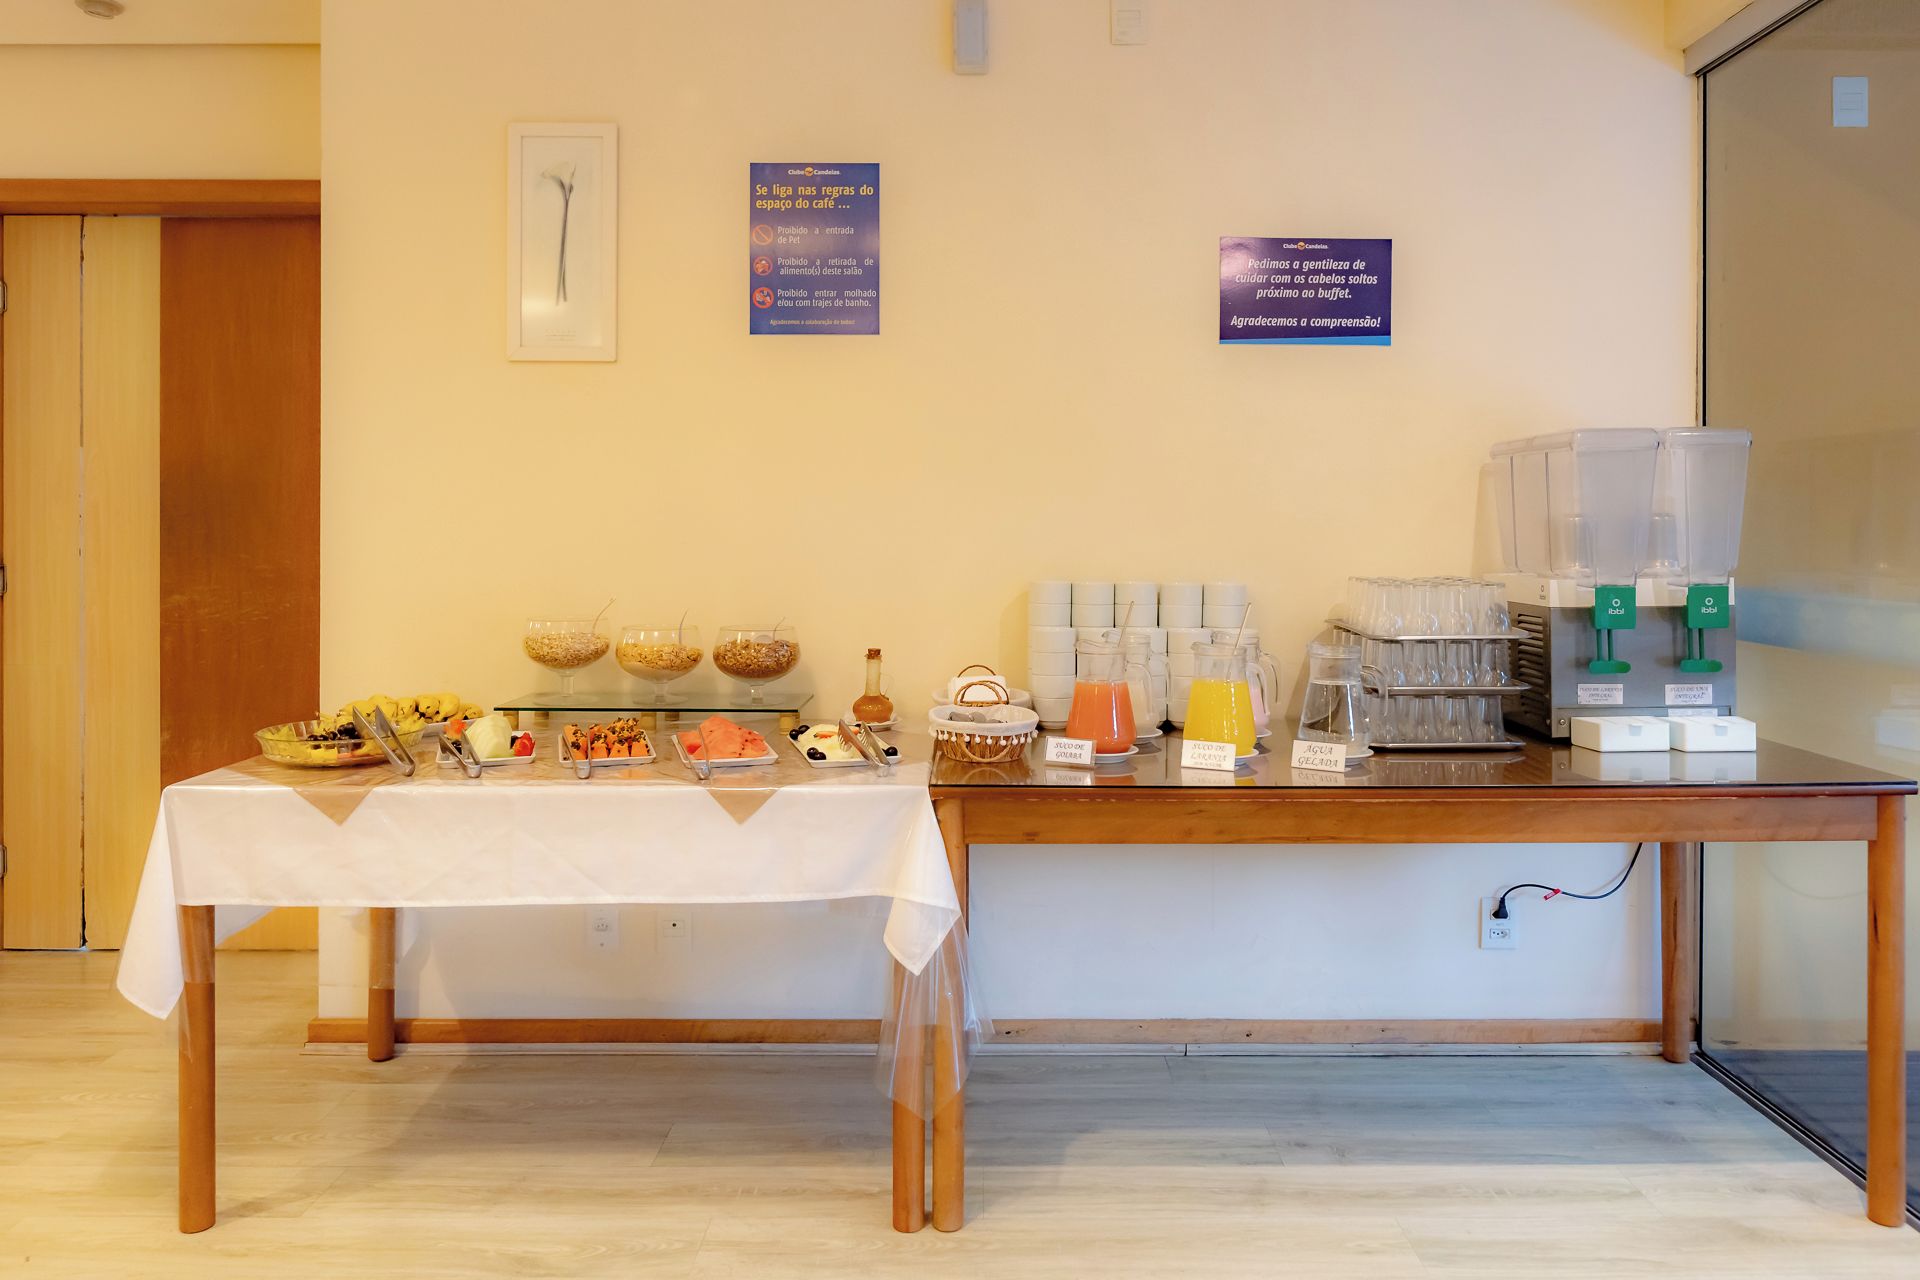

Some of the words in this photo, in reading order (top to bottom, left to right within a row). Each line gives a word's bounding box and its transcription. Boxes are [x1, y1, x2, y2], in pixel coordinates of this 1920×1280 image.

[755, 184, 768, 196] Se
[772, 184, 793, 198] liga
[798, 187, 817, 196] nas
[821, 186, 855, 198] regras
[859, 184, 874, 196] do
[755, 199, 792, 211] espaço
[795, 197, 809, 209] do
[812, 197, 835, 209] café
[777, 226, 808, 234] Proibido
[825, 226, 854, 234] entrada
[777, 235, 787, 244] de
[788, 235, 800, 244] Pet
[777, 257, 808, 266] Proibido
[828, 257, 857, 266] retirada
[864, 257, 874, 266] de
[1248, 258, 1290, 269] Pedimos
[1293, 261, 1300, 269] a
[1302, 258, 1350, 272] gentileza
[1352, 259, 1366, 270] de
[779, 267, 821, 276] alimento(s)
[822, 267, 841, 275] deste
[843, 266, 863, 275] salão
[1235, 272, 1268, 283] cuidar
[1270, 275, 1291, 283] com
[1294, 275, 1305, 284] os
[1308, 273, 1346, 284] cabelos
[1347, 274, 1378, 285] soltos
[777, 289, 808, 297] Proibido
[814, 289, 837, 297] entrar
[844, 288, 877, 297] molhado
[1256, 286, 1299, 300] próximo
[1301, 290, 1315, 298] ao
[1317, 287, 1352, 301] buffet.
[812, 299, 833, 309] trajes
[834, 299, 843, 307] de
[845, 299, 872, 307] banho.
[1230, 315, 1298, 329] Agradecemos
[1300, 318, 1307, 327] a
[1310, 315, 1381, 329] compreensão!
[1608, 607, 1625, 615] ibbl
[1701, 606, 1718, 614] ibbl
[1054, 741, 1073, 750] SUCO
[1191, 742, 1213, 750] SUCO
[1303, 743, 1333, 756] ÁGUA
[1055, 751, 1082, 760] GOIABA
[1190, 751, 1227, 762] LARANJA
[1297, 756, 1338, 768] GELADA
